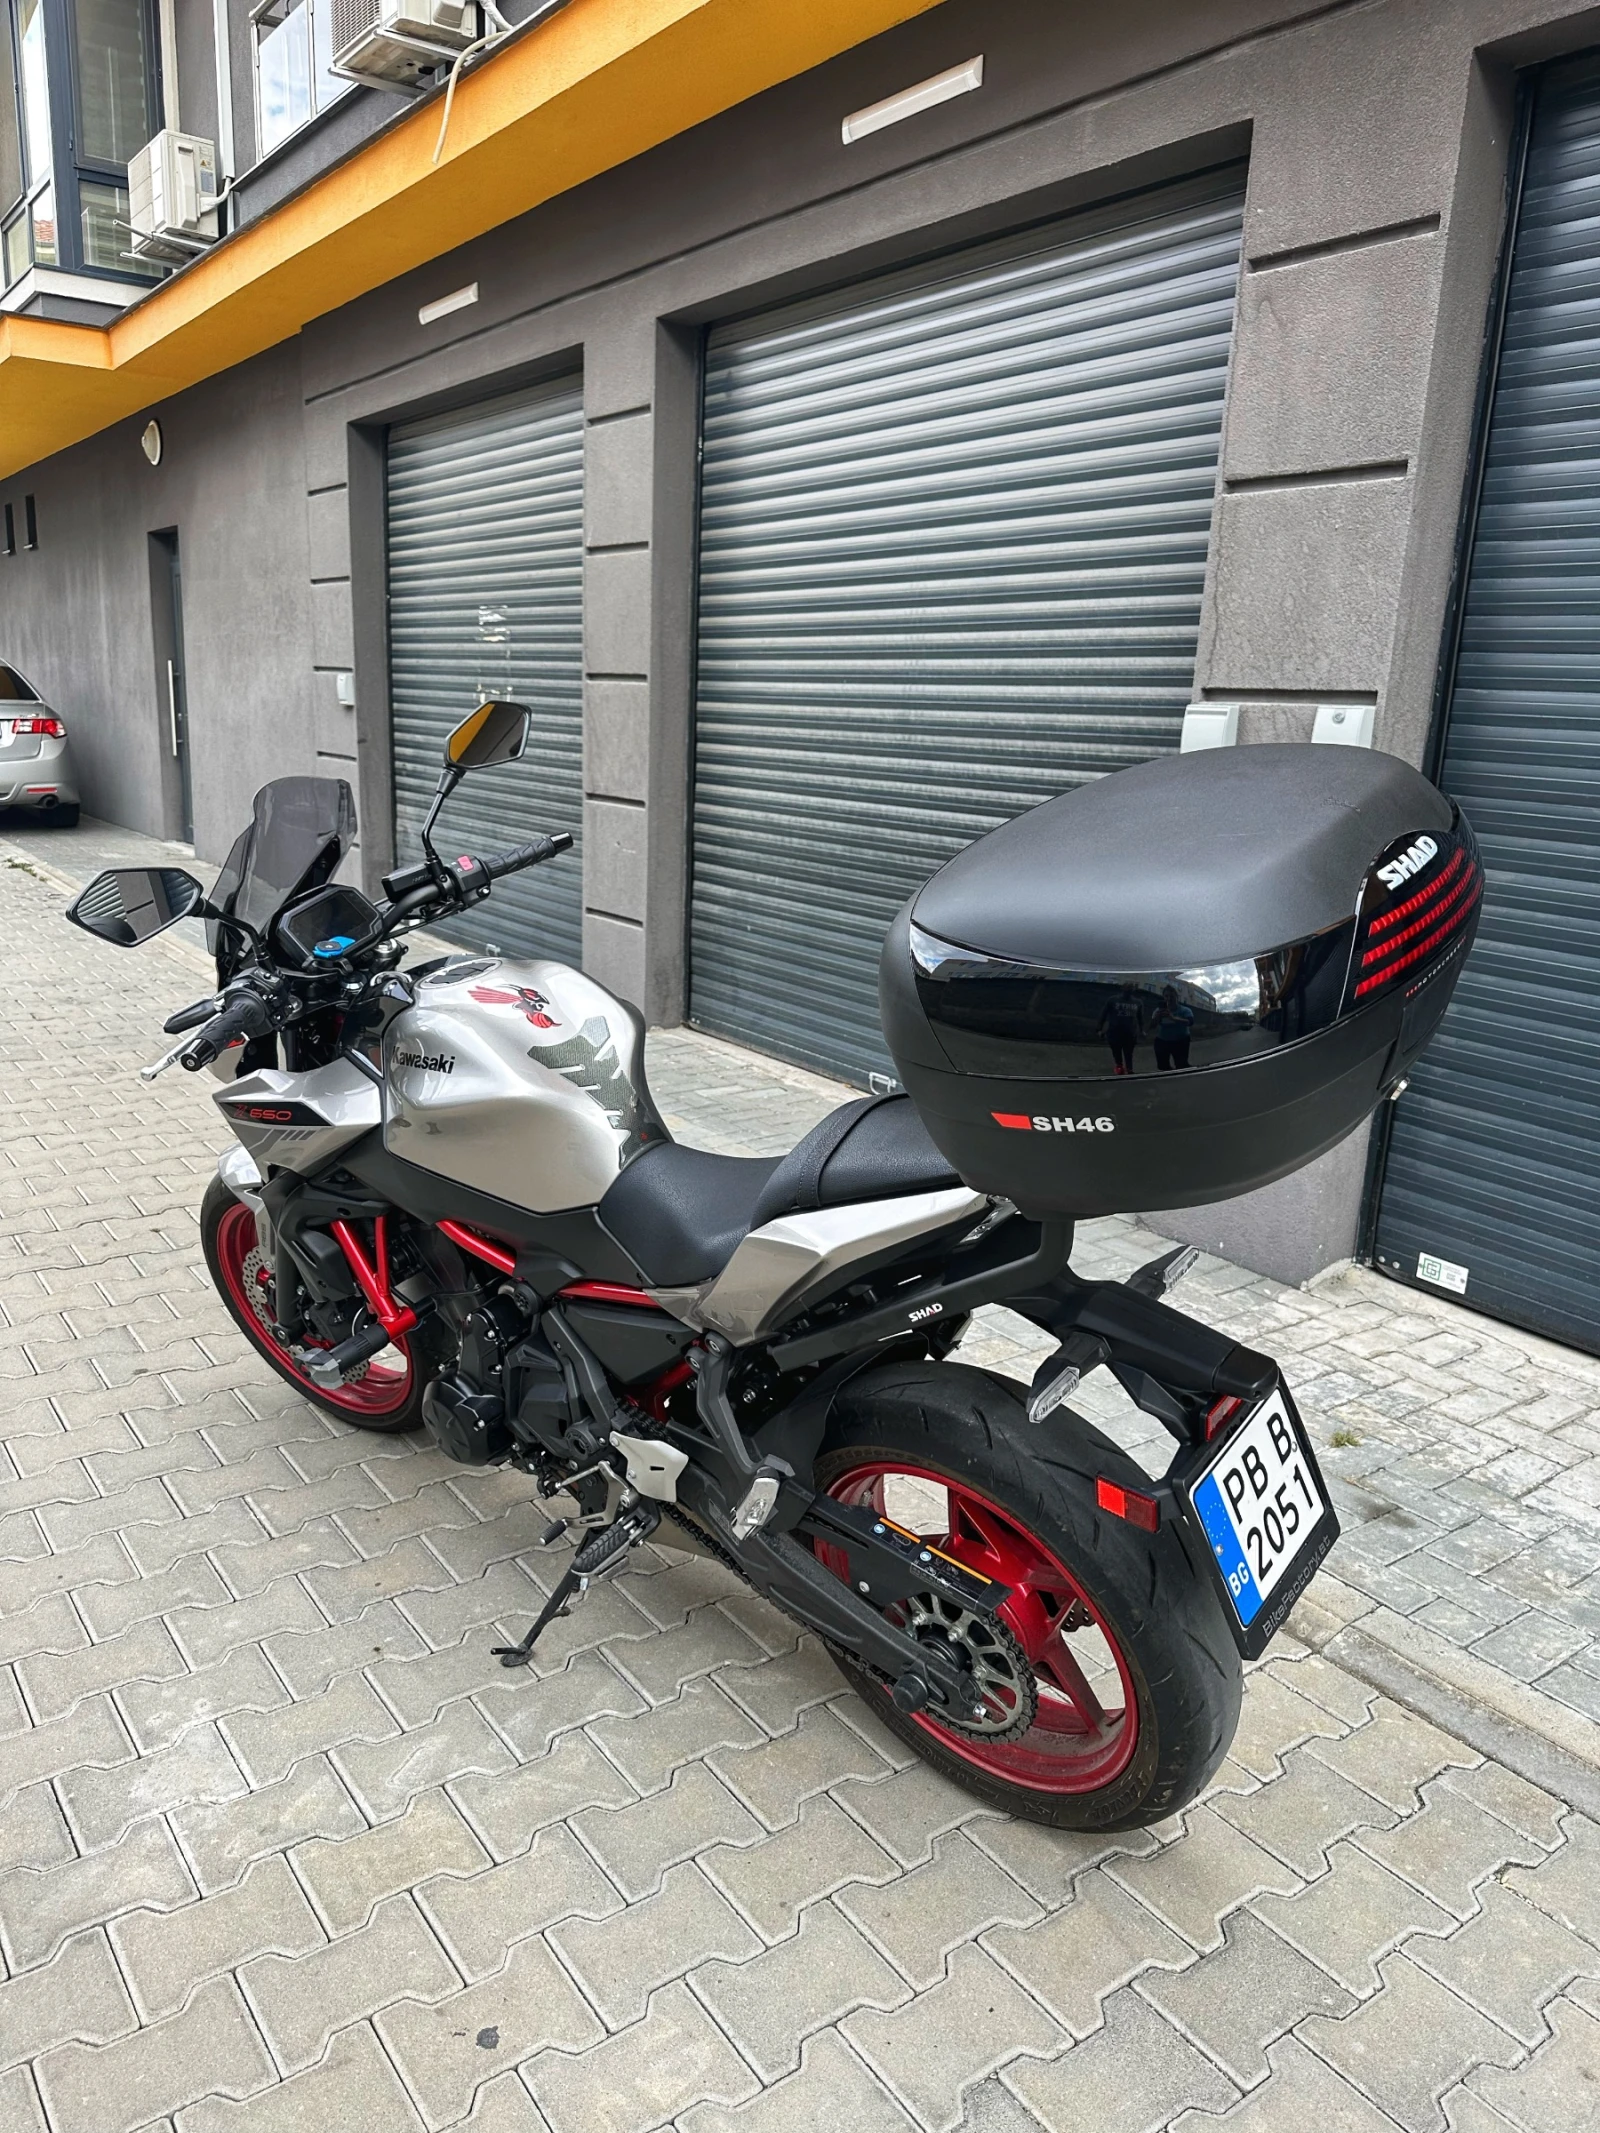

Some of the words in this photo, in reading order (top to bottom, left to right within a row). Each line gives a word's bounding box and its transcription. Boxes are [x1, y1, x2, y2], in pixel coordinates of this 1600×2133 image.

[1376, 835, 1439, 891] SHAD
[392, 1045, 456, 1074] Kawasaki
[1032, 1116, 1115, 1132] SH46
[908, 1303, 943, 1322] SHAD
[1223, 1445, 1268, 1525] PB
[1267, 1412, 1292, 1465] B
[1247, 1464, 1314, 1582] 2051
[1228, 1562, 1250, 1599] BG
